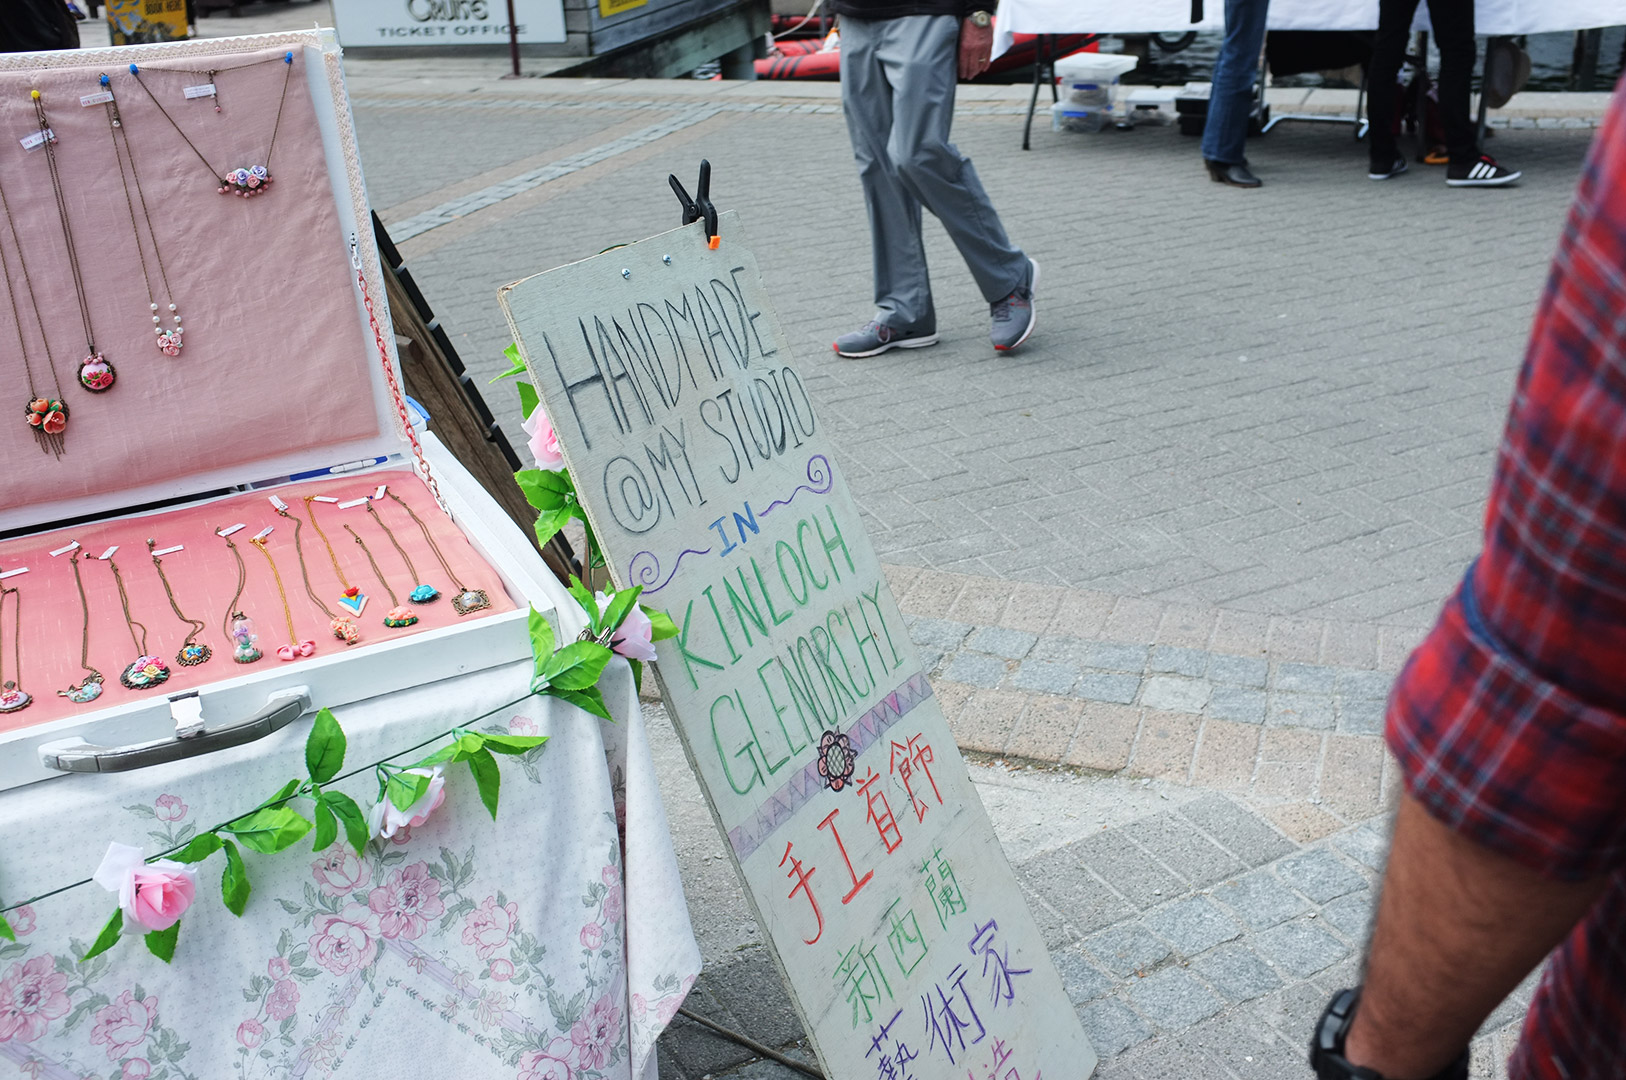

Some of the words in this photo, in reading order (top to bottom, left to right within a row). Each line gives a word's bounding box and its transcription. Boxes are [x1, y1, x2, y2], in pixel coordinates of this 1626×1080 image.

[377, 26, 447, 37] TICKET
[542, 266, 777, 450] HANDMADE
[603, 417, 708, 533] @MY
[700, 367, 815, 484] STUDIO
[708, 501, 760, 557] IN
[665, 505, 855, 690] KINLOCH
[710, 580, 905, 795] GLENORCHY
[777, 732, 943, 945] 手工首飾
[832, 848, 967, 1030] 新西蘭
